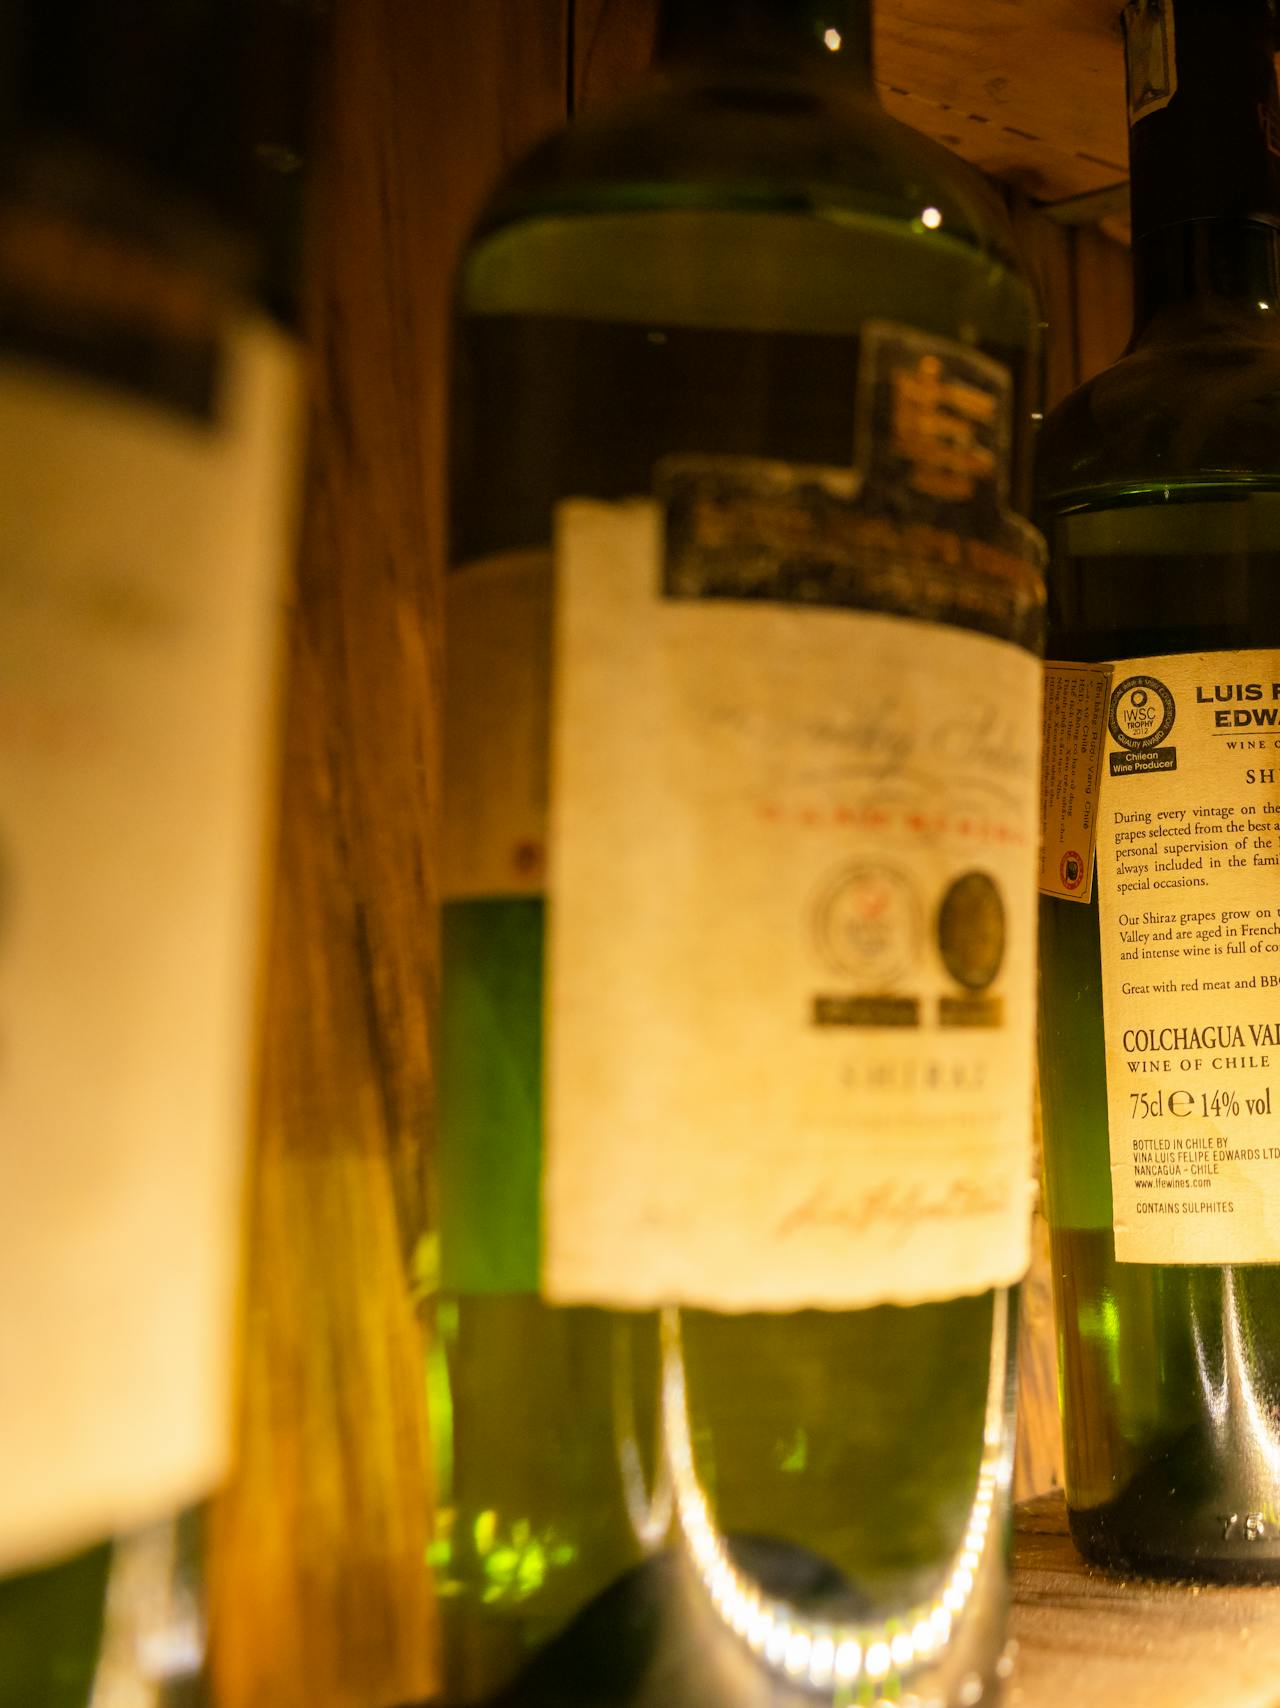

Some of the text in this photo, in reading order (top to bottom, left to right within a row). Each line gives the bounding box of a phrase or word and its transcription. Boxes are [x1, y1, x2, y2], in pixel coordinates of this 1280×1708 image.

[1196, 684, 1263, 704] LUIS
[1124, 706, 1156, 722] IWSC
[1127, 720, 1154, 730] TROPHY
[1117, 730, 1165, 748] QUALITY AWARD
[1226, 740, 1265, 750] WINE
[1126, 752, 1158, 762] Chilean
[1113, 760, 1174, 772] Wine Producer
[1114, 811, 1152, 824] During
[1157, 810, 1186, 822] every
[1193, 806, 1235, 819] vintage
[1241, 806, 1256, 814] on
[1263, 802, 1280, 814] the
[1114, 828, 1146, 844] grapes
[1149, 824, 1191, 838] selected
[1194, 822, 1223, 834] from
[1226, 820, 1244, 832] the
[1248, 820, 1270, 832] best
[1116, 843, 1158, 861] personal
[1164, 840, 1228, 856] supervision
[1235, 837, 1249, 849] of
[1254, 837, 1272, 849] the
[1116, 862, 1148, 877] always
[1154, 857, 1203, 872] included
[1210, 857, 1221, 868] in
[1228, 855, 1247, 868] the
[1117, 876, 1209, 896] special occasions.
[1118, 914, 1140, 926] Our
[1142, 912, 1177, 924] Shiraz
[1180, 911, 1216, 926] grapes
[1222, 910, 1250, 924] grow
[1256, 910, 1270, 918] on
[1120, 930, 1150, 944] Valley
[1152, 928, 1173, 941] and
[1176, 930, 1192, 940] are
[1196, 925, 1222, 941] aged
[1226, 926, 1237, 936] in
[1241, 922, 1280, 936] French
[1120, 948, 1139, 960] and
[1142, 948, 1180, 960] intense
[1183, 944, 1210, 956] wine
[1214, 944, 1223, 954] is
[1226, 941, 1246, 954] full
[1250, 940, 1264, 953] of
[1122, 982, 1150, 995] Great
[1153, 980, 1177, 993] with
[1181, 979, 1198, 992] red
[1202, 980, 1231, 991] meat
[1234, 976, 1256, 989] and
[1123, 1026, 1246, 1052] COLCHAGUA
[1128, 1056, 1270, 1073] WINE OF CHILE
[1130, 1090, 1163, 1119] 75cl
[1202, 1089, 1240, 1118] 14%
[1246, 1087, 1272, 1116] vol
[1133, 1138, 1228, 1150] BOTTLED IN CHILE BY
[1155, 1152, 1175, 1163] LUIS
[1178, 1150, 1209, 1162] FELIPE
[1213, 1149, 1260, 1161] EDWARDS
[1134, 1164, 1181, 1176] NANCAGUA
[1190, 1163, 1219, 1175] CHILE
[1135, 1178, 1211, 1188] www.lfewines.com
[1136, 1201, 1234, 1214] CONTAINS SULPHITES
